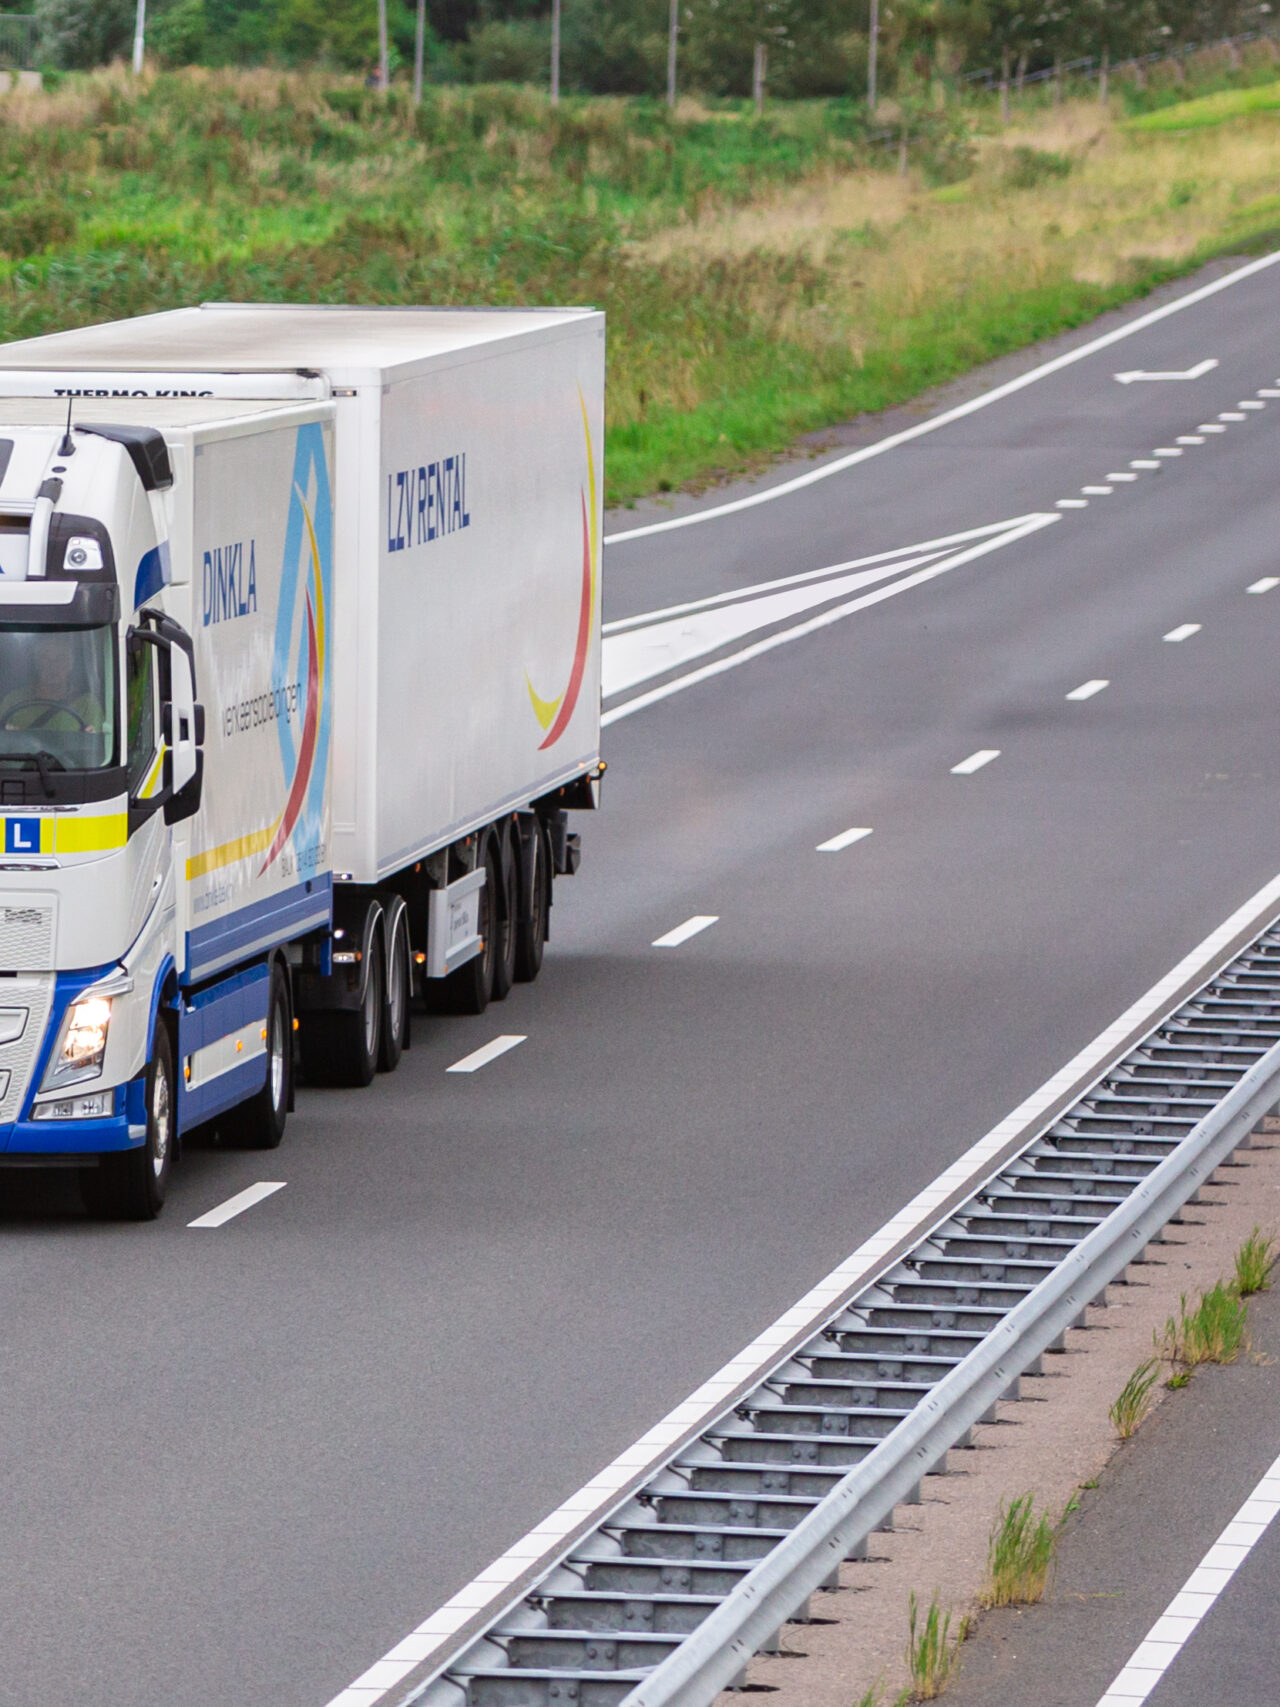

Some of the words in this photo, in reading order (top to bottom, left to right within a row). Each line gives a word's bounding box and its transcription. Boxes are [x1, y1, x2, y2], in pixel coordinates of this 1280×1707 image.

[388, 469, 415, 553] LZV
[417, 452, 470, 545] RENTAL
[203, 539, 257, 627] DINKLA
[14, 823, 31, 848] L
